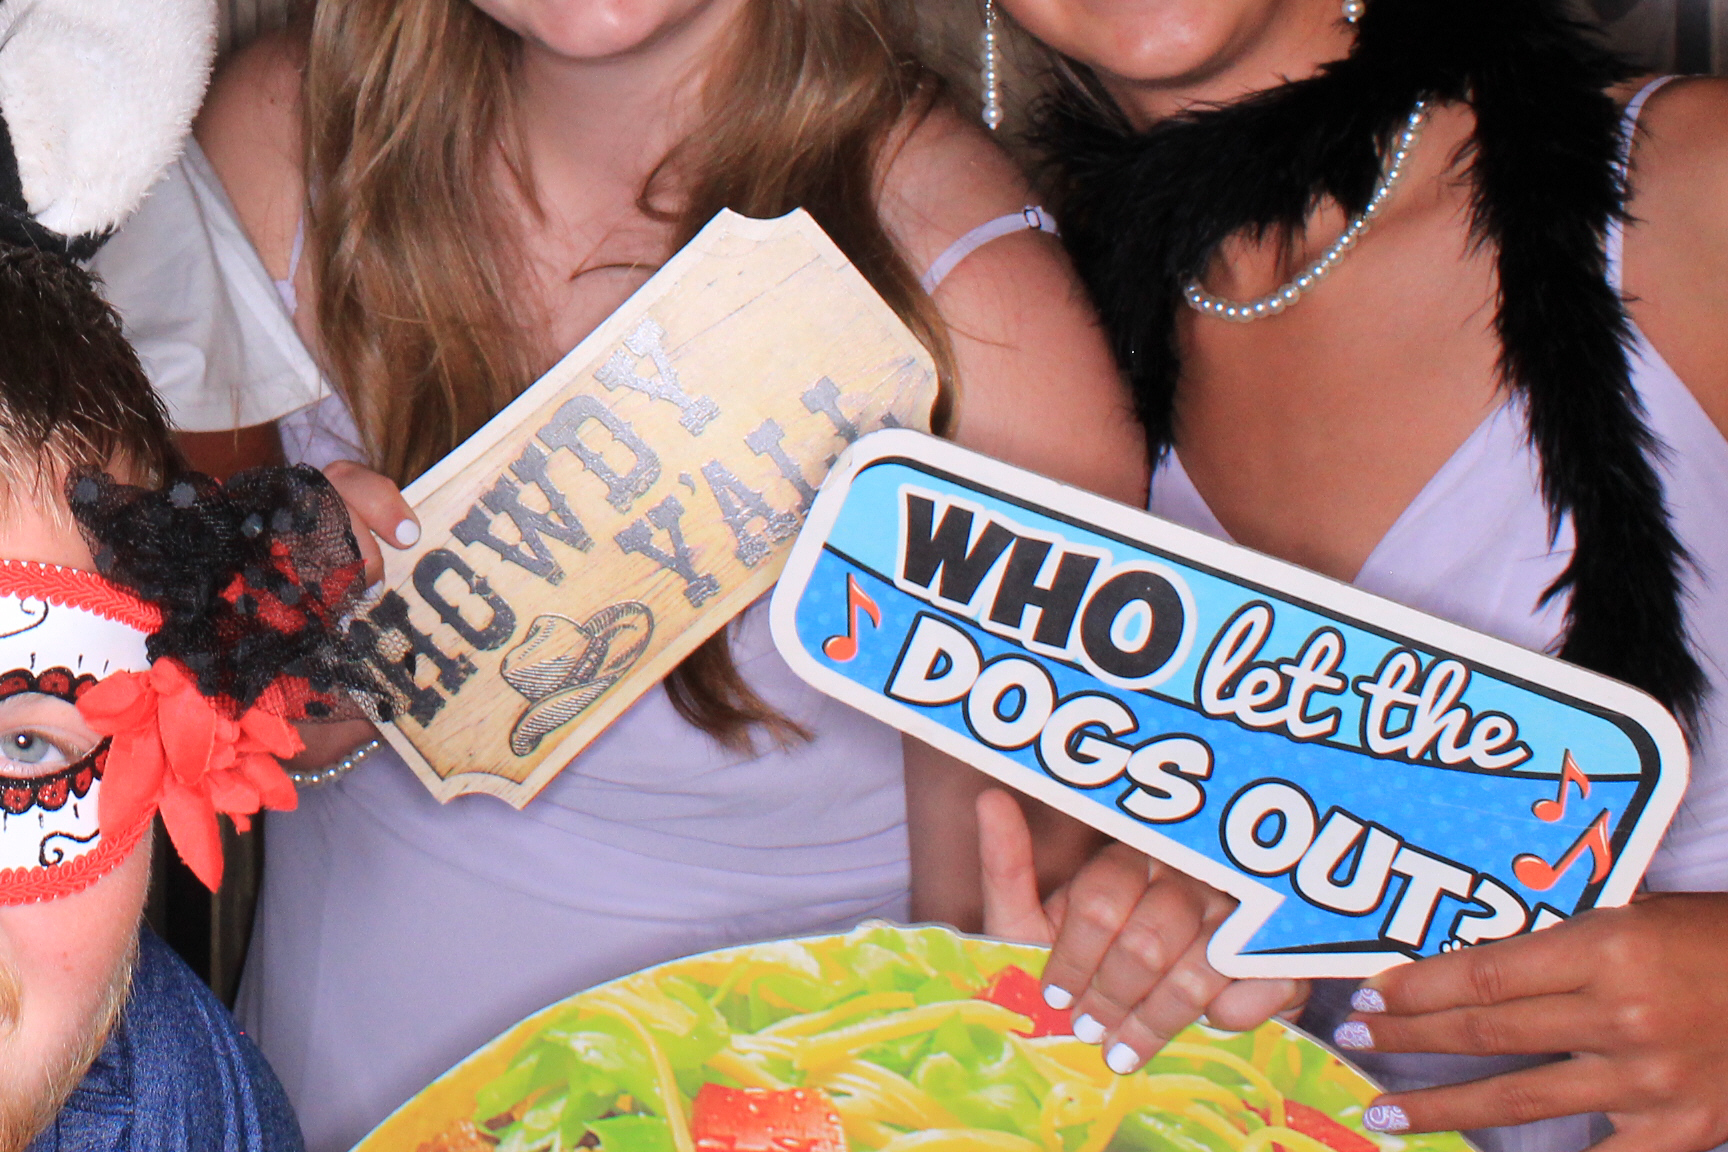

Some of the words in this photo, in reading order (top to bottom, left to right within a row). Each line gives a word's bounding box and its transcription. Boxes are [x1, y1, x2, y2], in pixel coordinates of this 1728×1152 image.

[350, 317, 721, 728] HOWDY
[900, 490, 1188, 682] WHO
[1198, 600, 1348, 740] let
[1354, 646, 1532, 770] the
[887, 611, 1214, 824] DOGS
